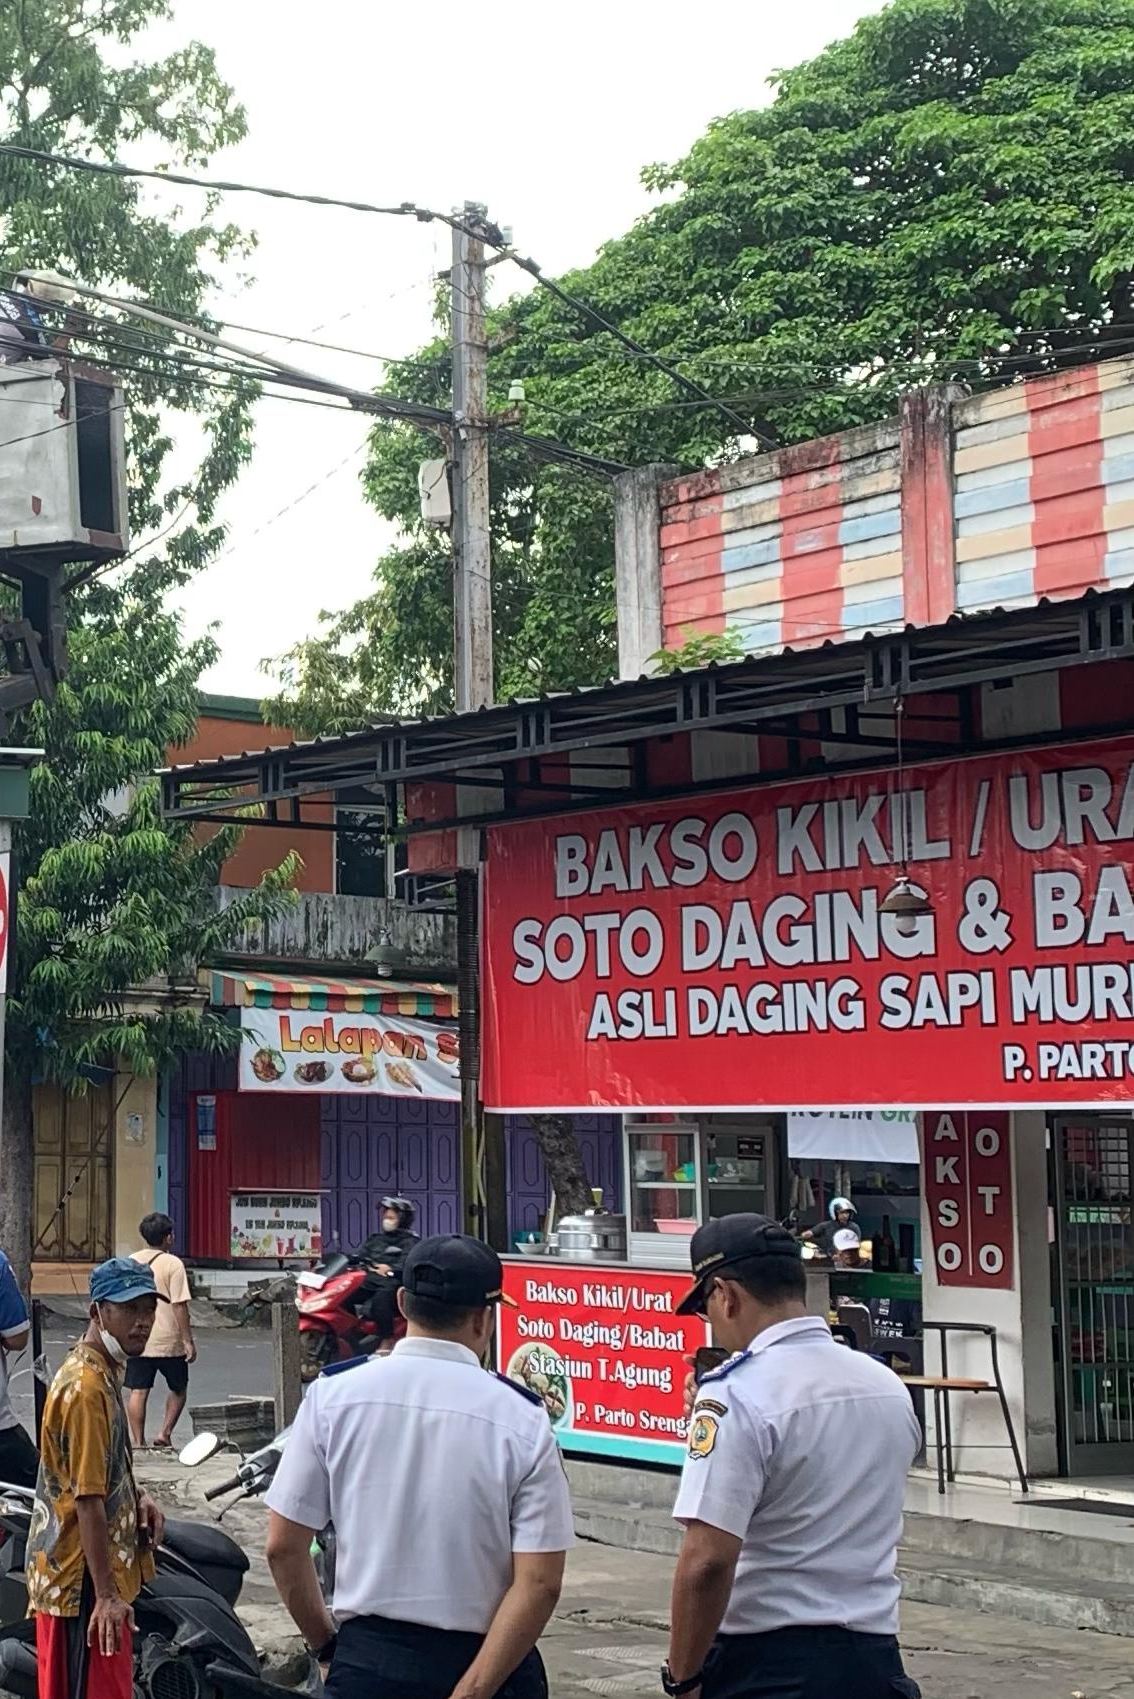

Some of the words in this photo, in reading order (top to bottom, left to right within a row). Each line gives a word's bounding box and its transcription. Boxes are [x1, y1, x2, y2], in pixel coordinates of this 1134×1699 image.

[556, 812, 759, 898] BAKSO
[777, 789, 951, 876] KIKIL
[970, 781, 990, 857] /
[513, 908, 664, 984] SOTO
[682, 883, 937, 972] DAGING
[958, 878, 1013, 952] &
[587, 989, 678, 1041] ASLI
[688, 978, 865, 1037] DAGING
[879, 970, 997, 1030] SAPI
[1011, 962, 1134, 1023] MUR
[279, 1015, 429, 1062] Lalapan
[1004, 1045, 1033, 1081] P.
[1039, 1041, 1134, 1079] PART
[526, 1280, 578, 1306] Bakso
[583, 1284, 673, 1314] Kikil/Urat
[517, 1314, 555, 1339] Soto
[560, 1318, 685, 1351] Daging/Babat
[529, 1351, 592, 1380] Stasiun
[597, 1358, 673, 1393] T.Agung
[575, 1402, 590, 1422] P.
[594, 1404, 635, 1428] Parto
